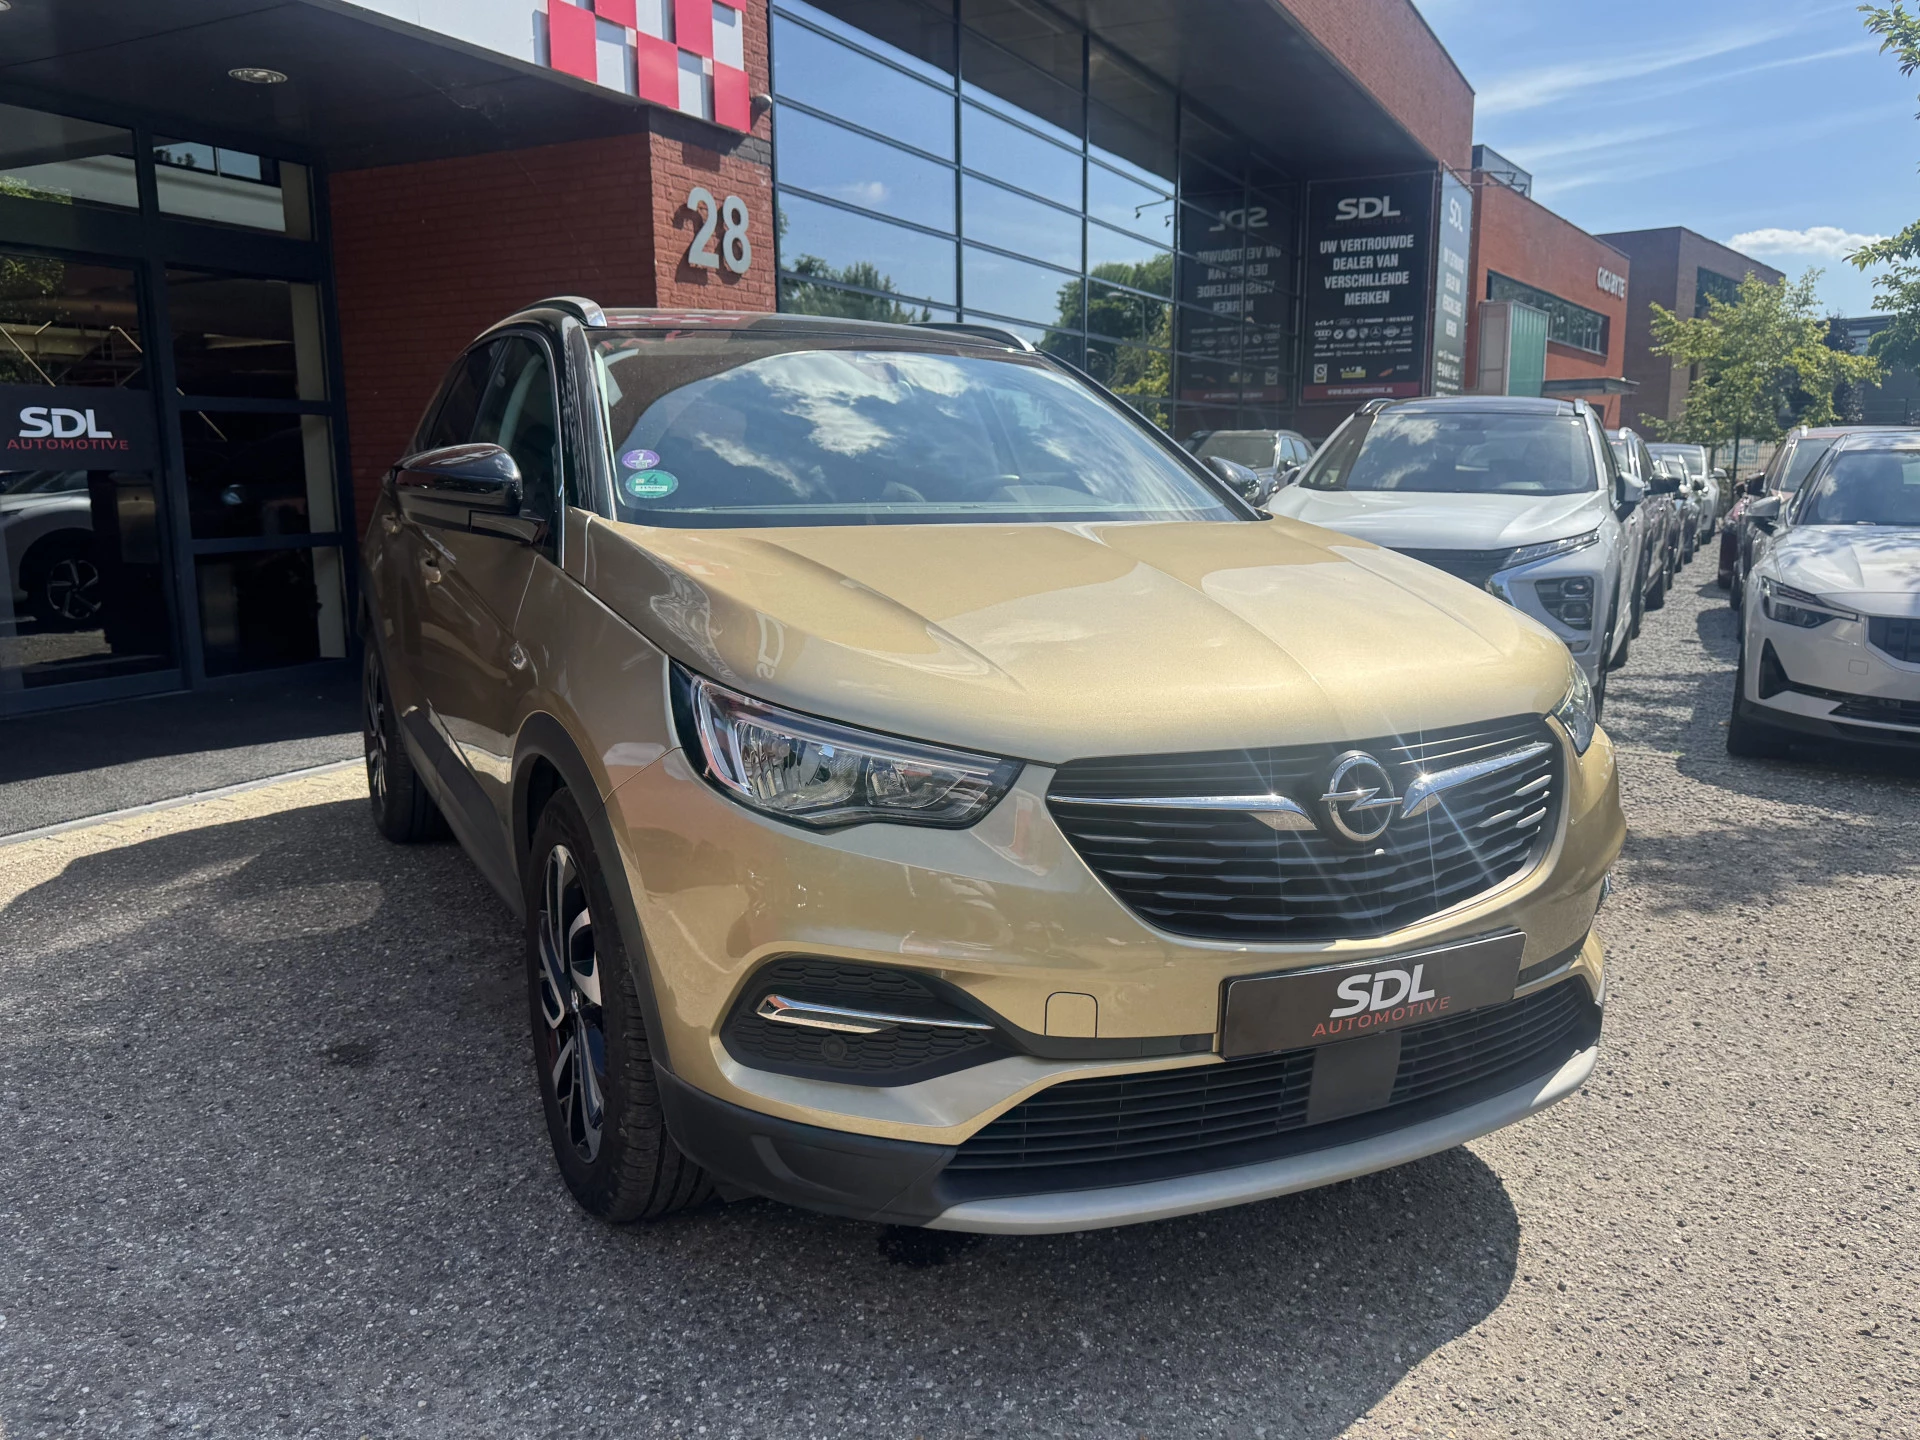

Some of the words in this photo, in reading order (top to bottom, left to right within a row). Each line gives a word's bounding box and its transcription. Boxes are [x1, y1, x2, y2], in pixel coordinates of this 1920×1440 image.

[1335, 195, 1401, 220] SDL
[687, 187, 752, 274] 28
[1319, 240, 1338, 254] UW
[1340, 234, 1415, 252] VERTROUWDE
[1333, 256, 1374, 271] DEALER
[1376, 253, 1399, 269] VAN
[1324, 271, 1410, 290] VERSCHILLENDE
[1344, 290, 1391, 306] MERKEN
[19, 406, 113, 438] SDL
[7, 439, 129, 450] AUTOMOTIVE
[1329, 963, 1435, 1018] SDL
[1312, 996, 1451, 1037] AUTOMOTIVE
